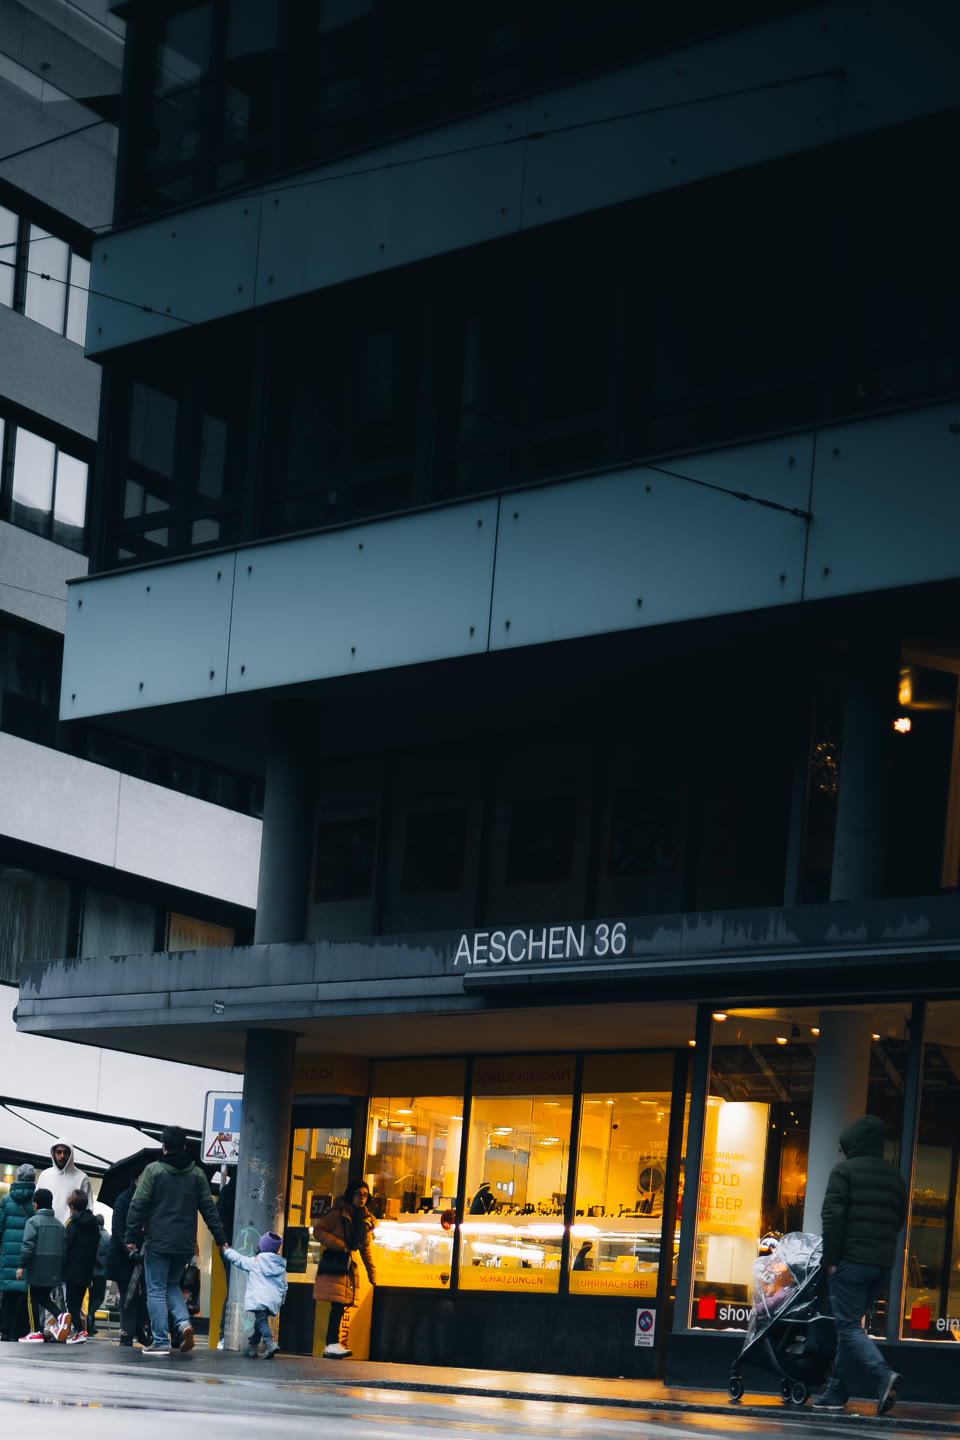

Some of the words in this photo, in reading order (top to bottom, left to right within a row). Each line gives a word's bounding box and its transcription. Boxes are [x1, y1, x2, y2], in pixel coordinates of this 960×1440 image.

[453, 924, 585, 966] AESCHEN
[593, 922, 627, 956] 36
[701, 1170, 740, 1187] GOLD
[580, 1279, 648, 1290] UHRMACHEREI
